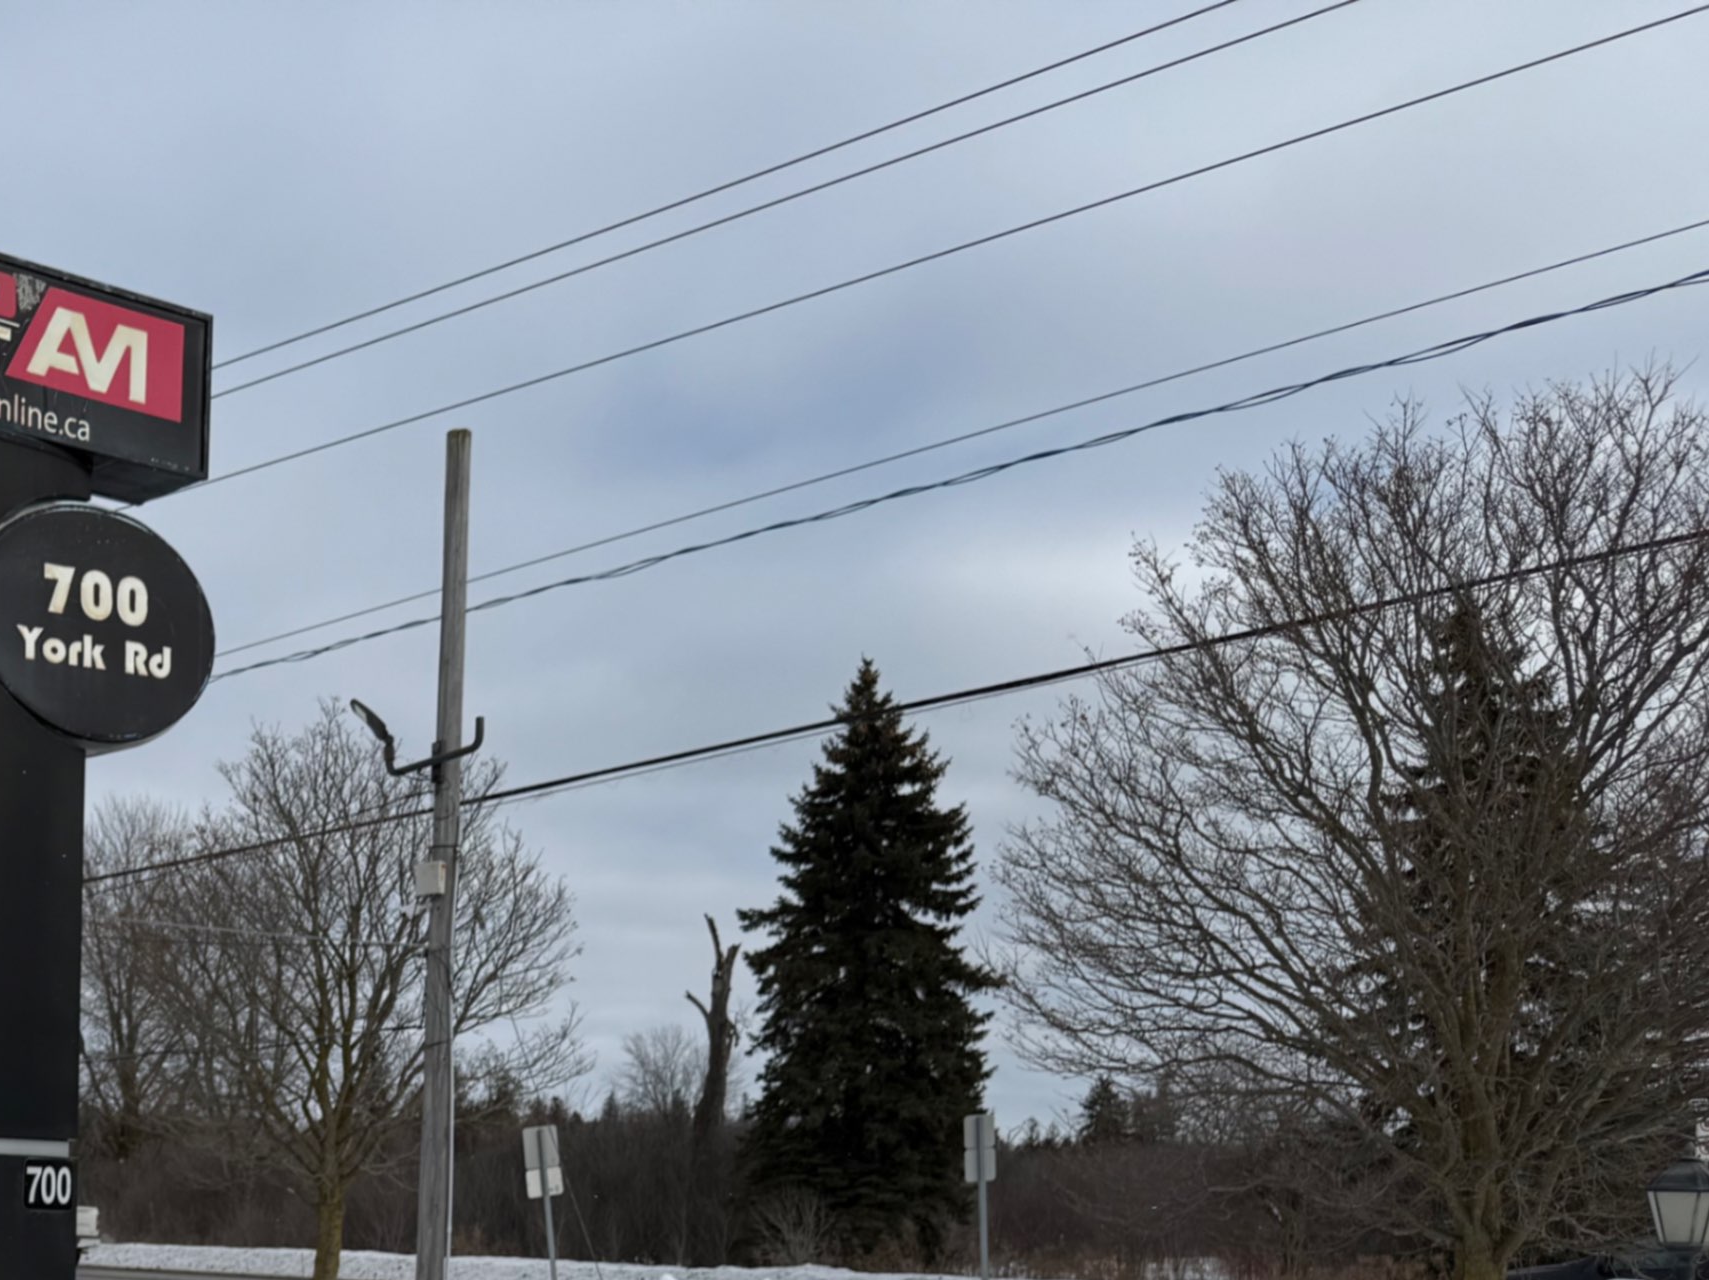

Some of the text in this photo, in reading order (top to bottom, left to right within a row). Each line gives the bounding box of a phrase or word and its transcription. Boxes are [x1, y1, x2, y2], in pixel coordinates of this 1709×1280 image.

[43, 562, 149, 627] 700
[17, 624, 172, 679] York Rd
[25, 1165, 72, 1205] 700
